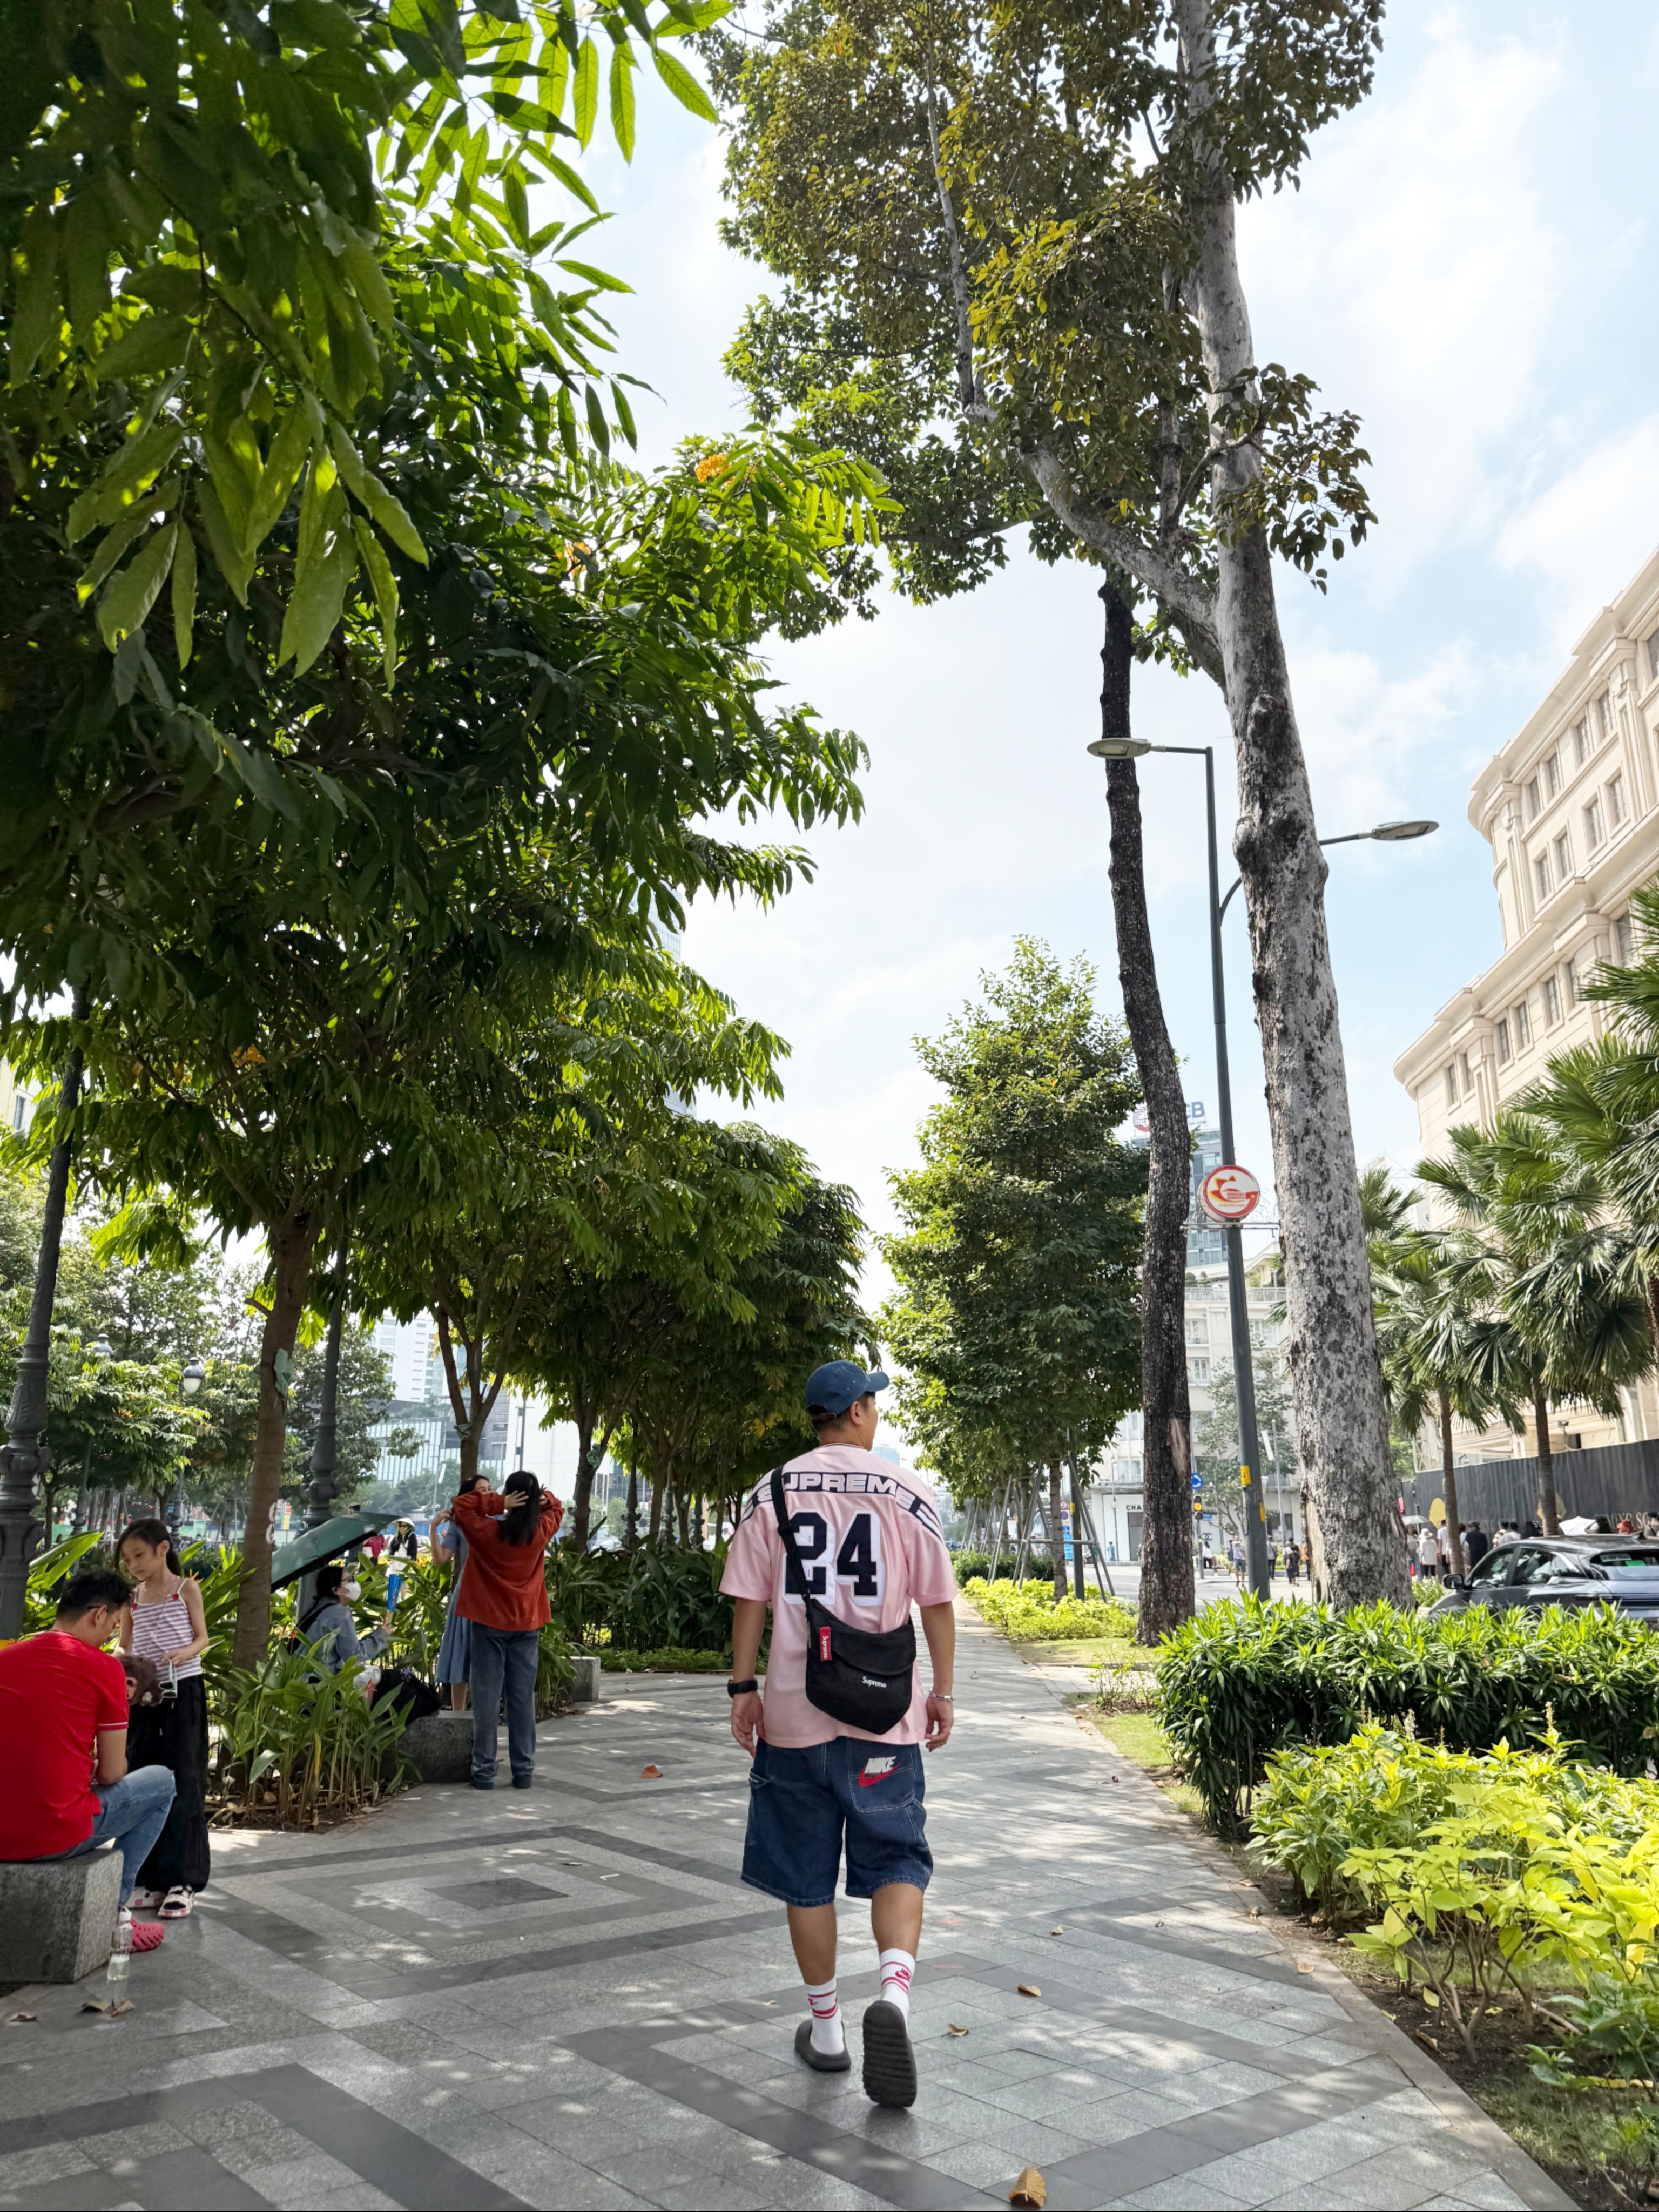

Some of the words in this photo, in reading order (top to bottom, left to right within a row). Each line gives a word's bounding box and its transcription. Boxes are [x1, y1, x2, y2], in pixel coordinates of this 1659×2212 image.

[757, 1473, 916, 1510] SUPREME
[784, 1511, 882, 1600] 24
[861, 1676, 887, 1688] Supreme
[865, 1756, 896, 1775] NIKE
